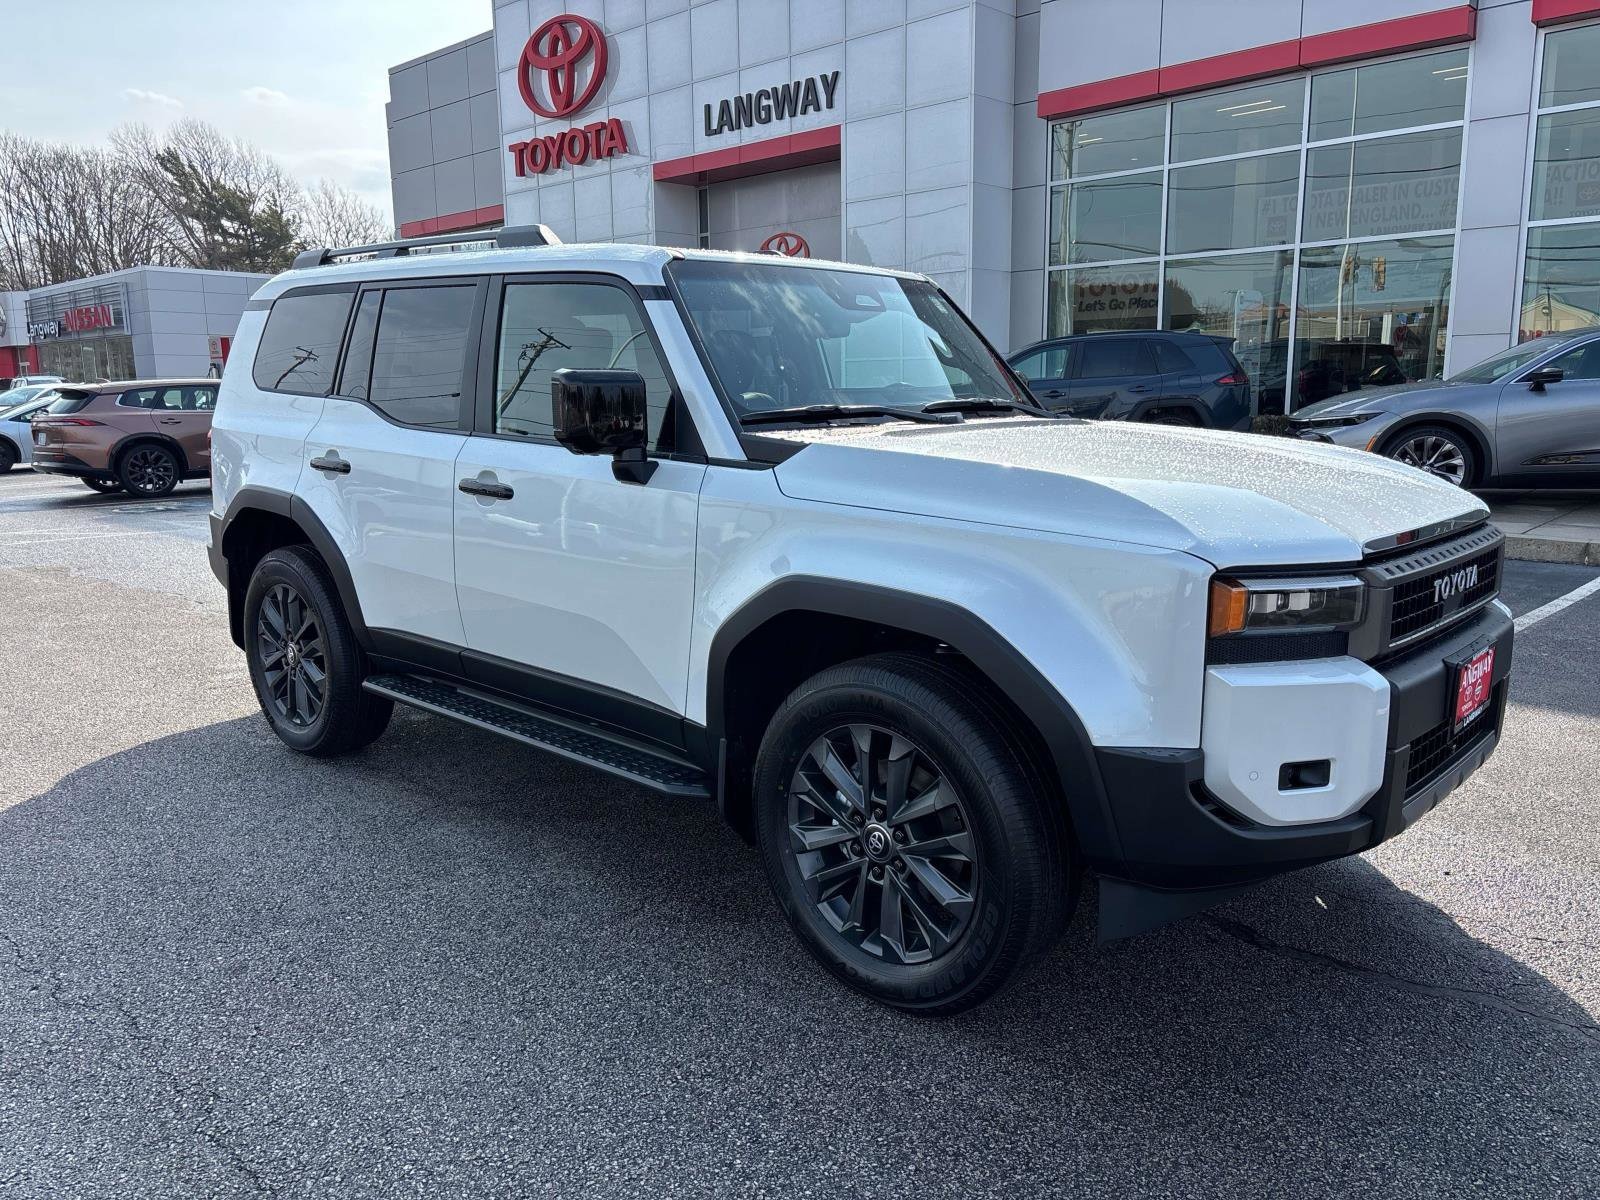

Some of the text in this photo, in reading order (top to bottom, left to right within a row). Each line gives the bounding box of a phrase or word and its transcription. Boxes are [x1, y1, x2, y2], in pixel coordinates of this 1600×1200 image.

[703, 71, 839, 137] LANGWAY
[509, 118, 629, 178] TOYOTA
[1283, 190, 1336, 213] TOOTA
[1338, 186, 1388, 208] DALER
[1393, 182, 1410, 201] IN
[27, 304, 113, 339] Langway NISSAN
[1078, 299, 1106, 313] Let's
[1108, 298, 1126, 311] Go
[1434, 564, 1478, 603] TOYOTA
